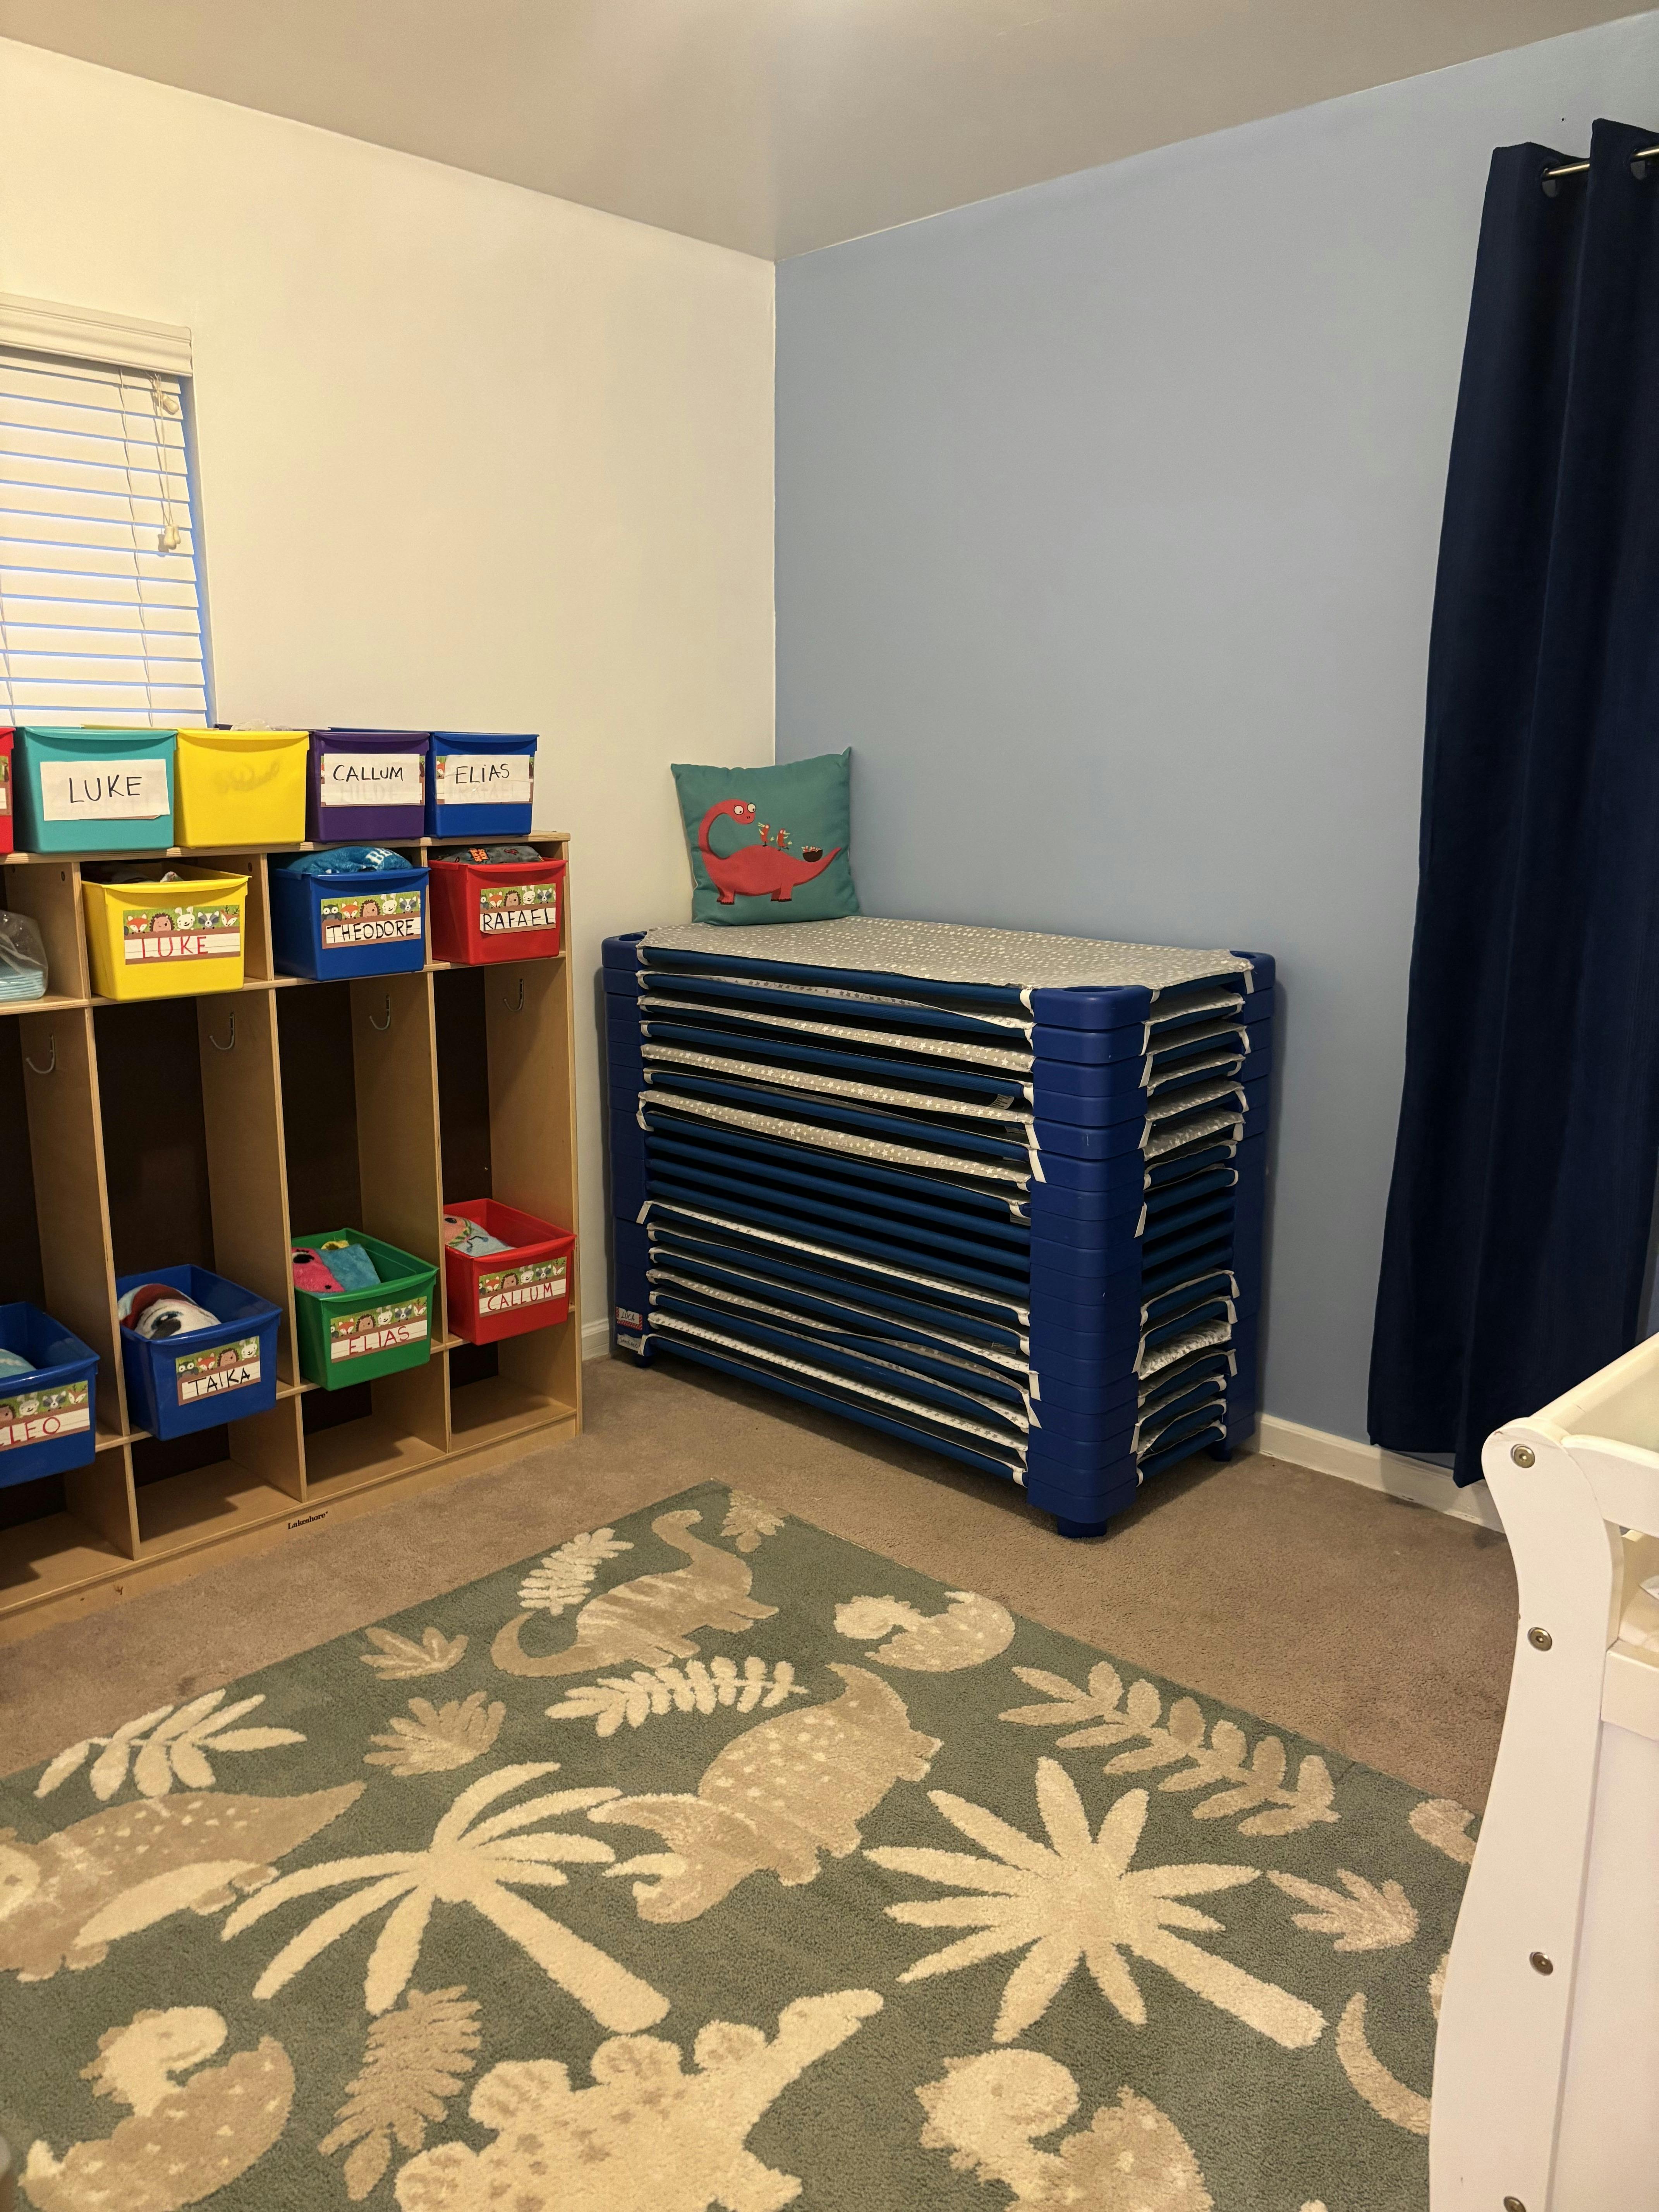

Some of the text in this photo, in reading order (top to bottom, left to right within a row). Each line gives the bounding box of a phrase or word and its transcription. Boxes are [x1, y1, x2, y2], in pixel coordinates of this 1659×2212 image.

[333, 764, 404, 782] CALLUM
[69, 775, 143, 803] LUKE
[326, 919, 414, 943] THEODORE
[483, 908, 555, 931] RAFAEL
[142, 936, 208, 959] LUKE
[487, 1282, 553, 1310] CALLUM
[621, 1311, 635, 1321] LUCA
[349, 1326, 410, 1355] ELIAS
[187, 1367, 251, 1396] TAIKA
[0, 1417, 61, 1447] LEO
[287, 1512, 326, 1530] Lakeshore
